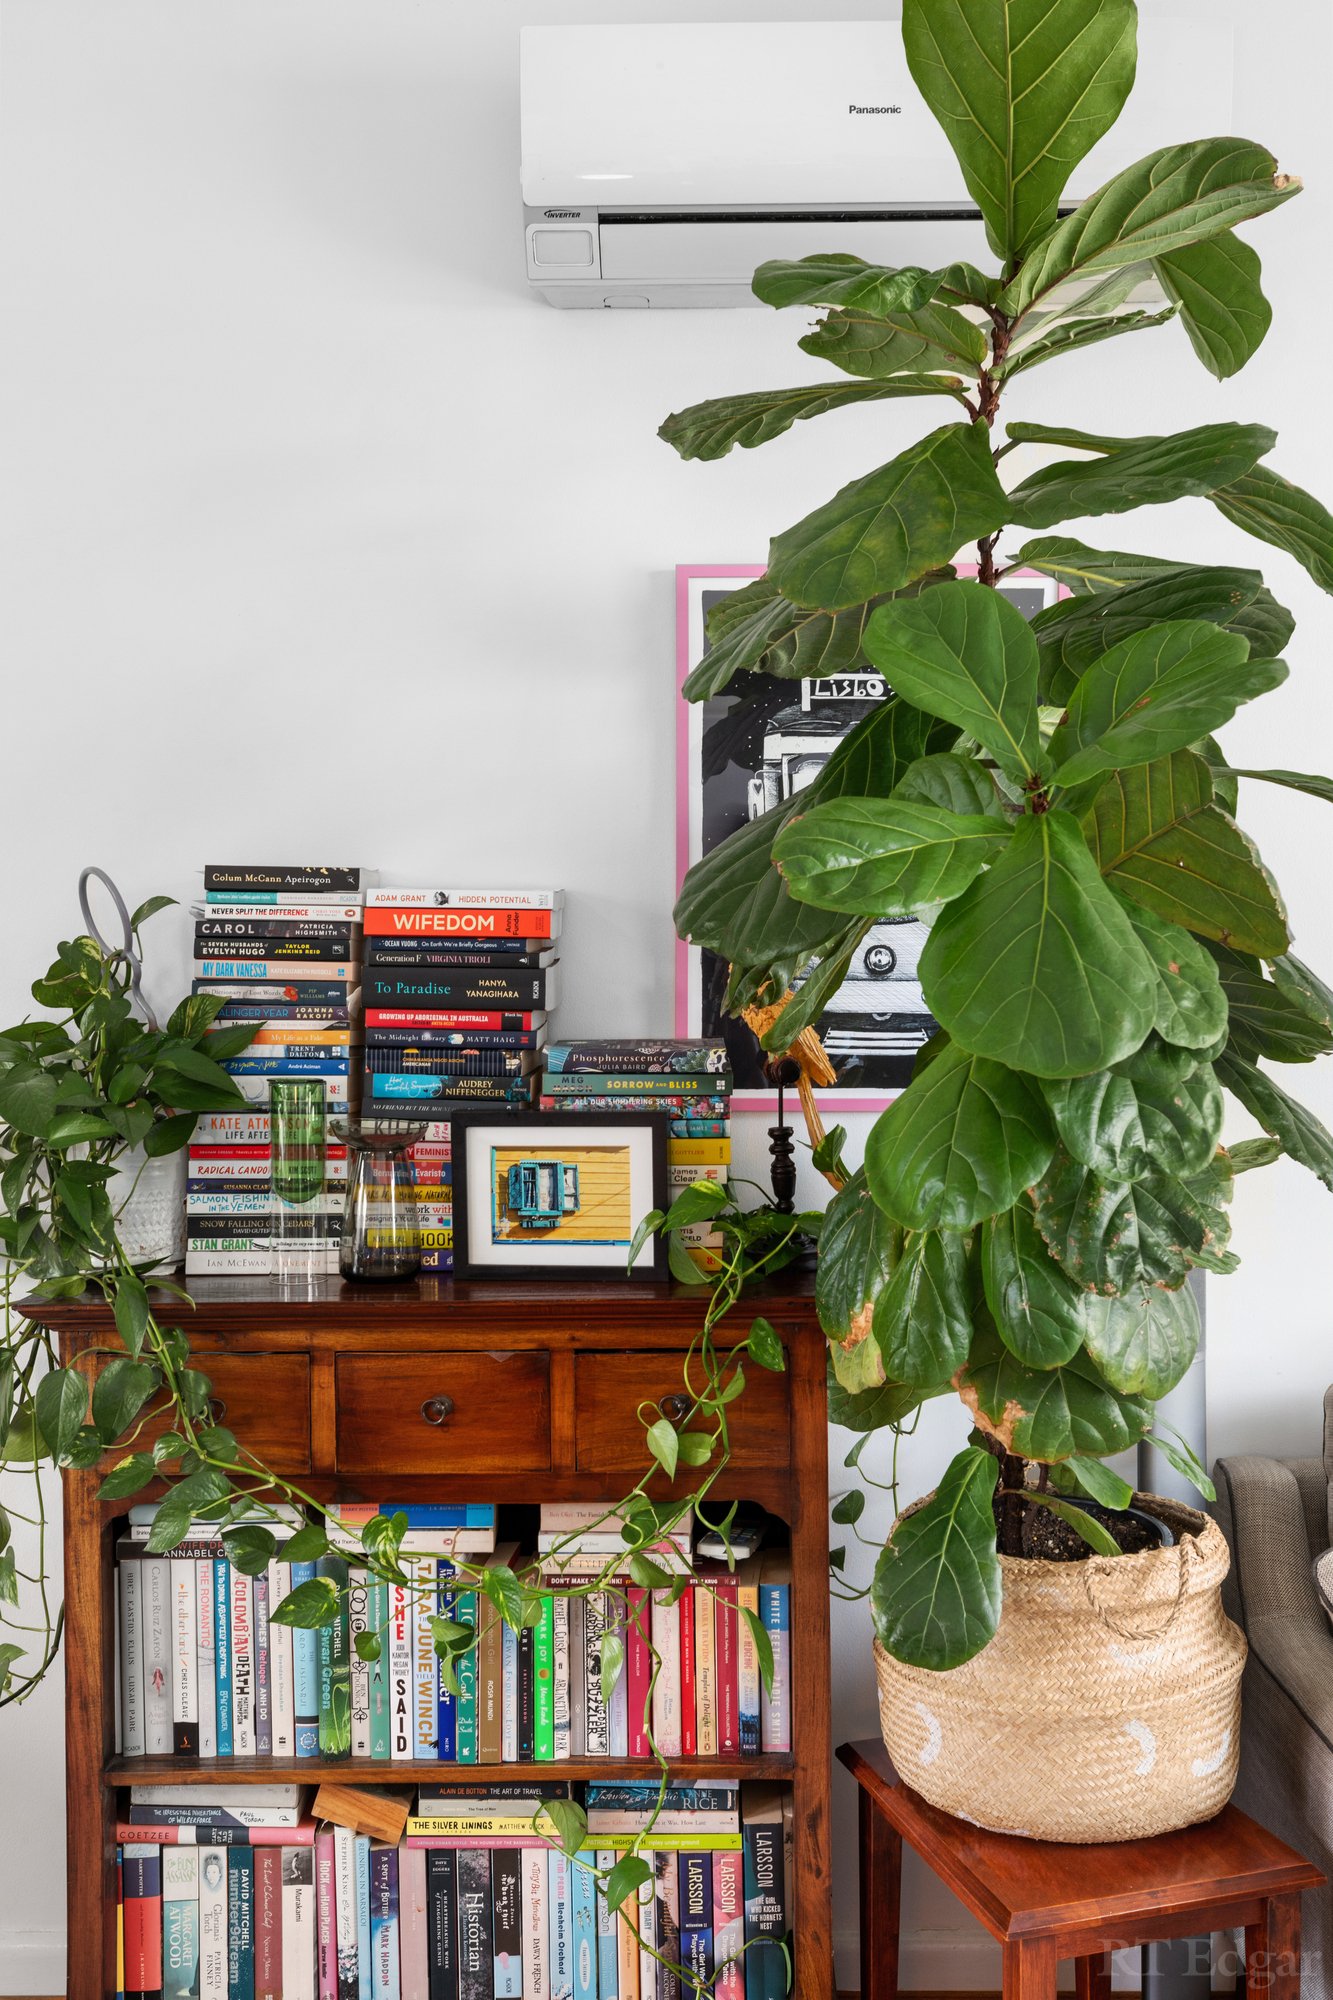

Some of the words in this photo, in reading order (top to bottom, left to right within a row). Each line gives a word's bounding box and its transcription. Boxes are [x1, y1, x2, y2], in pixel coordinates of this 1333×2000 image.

[849, 105, 901, 114] Panasonic
[815, 679, 890, 696] Lisbo
[212, 874, 242, 882] Colum
[245, 874, 281, 883] McCann
[285, 875, 331, 885] Apeirogon
[202, 924, 255, 933] CAROL
[394, 914, 494, 931] WIFEDOM
[377, 954, 415, 962] Generation
[427, 955, 462, 963] VIRGINIA
[203, 963, 215, 976] MY
[216, 964, 235, 976] DARK
[237, 964, 267, 977] VANESSA
[375, 982, 391, 993] To
[397, 982, 451, 994] Paradise
[573, 1054, 665, 1063] Phosphorescence
[446, 1088, 505, 1097] NIFFENEGGER
[458, 1080, 493, 1088] AUDREY
[211, 1119, 240, 1129] KATE
[198, 1166, 235, 1174] RADICAL
[190, 1195, 228, 1204] SALMON
[192, 1239, 217, 1249] STAN
[222, 1239, 253, 1249] GRANT
[200, 1564, 209, 1586] THE
[258, 1584, 266, 1599] The
[418, 1563, 432, 1615] TARA
[200, 1588, 210, 1647] ROMANTIC
[395, 1586, 405, 1640] SHE
[556, 1598, 566, 1628] RACHEL
[587, 1609, 596, 1648] HARDING
[321, 1627, 332, 1664] Swan
[419, 1623, 432, 1672] JUNE
[556, 1632, 566, 1654] CUSK
[258, 1650, 267, 1684] Refugee
[322, 1667, 332, 1709] Green
[701, 1667, 709, 1692] Temples
[505, 1671, 513, 1714] ENDURING
[556, 1679, 567, 1719] ARLINGTON
[260, 1709, 267, 1720] DO
[396, 1679, 407, 1752] SAID
[419, 1681, 432, 1745] WINCH
[588, 1682, 597, 1734] PUZZLER
[556, 1734, 567, 1751] PARK
[684, 1798, 717, 1809] RICE
[120, 1831, 169, 1840] COETZEE
[433, 1821, 458, 1829] SILVER
[462, 1821, 493, 1830] LININGS
[756, 1833, 773, 1887] LARSSON
[688, 1860, 703, 1913] LARSSON
[721, 1859, 735, 1913] LARSSON
[751, 1905, 763, 1913] WHO
[765, 1905, 781, 1913] KICKED
[204, 1912, 212, 1934] Torch
[229, 1869, 240, 1983] number9dream
[466, 1892, 483, 1971] Historian
[760, 1922, 773, 1930] NEST
[170, 1906, 180, 1968] ATWOOD
[183, 1906, 192, 1967] MARGARET
[381, 1925, 391, 1948] MARK
[382, 1952, 390, 1986] HADDON
[532, 1964, 541, 1993] FRENCH
